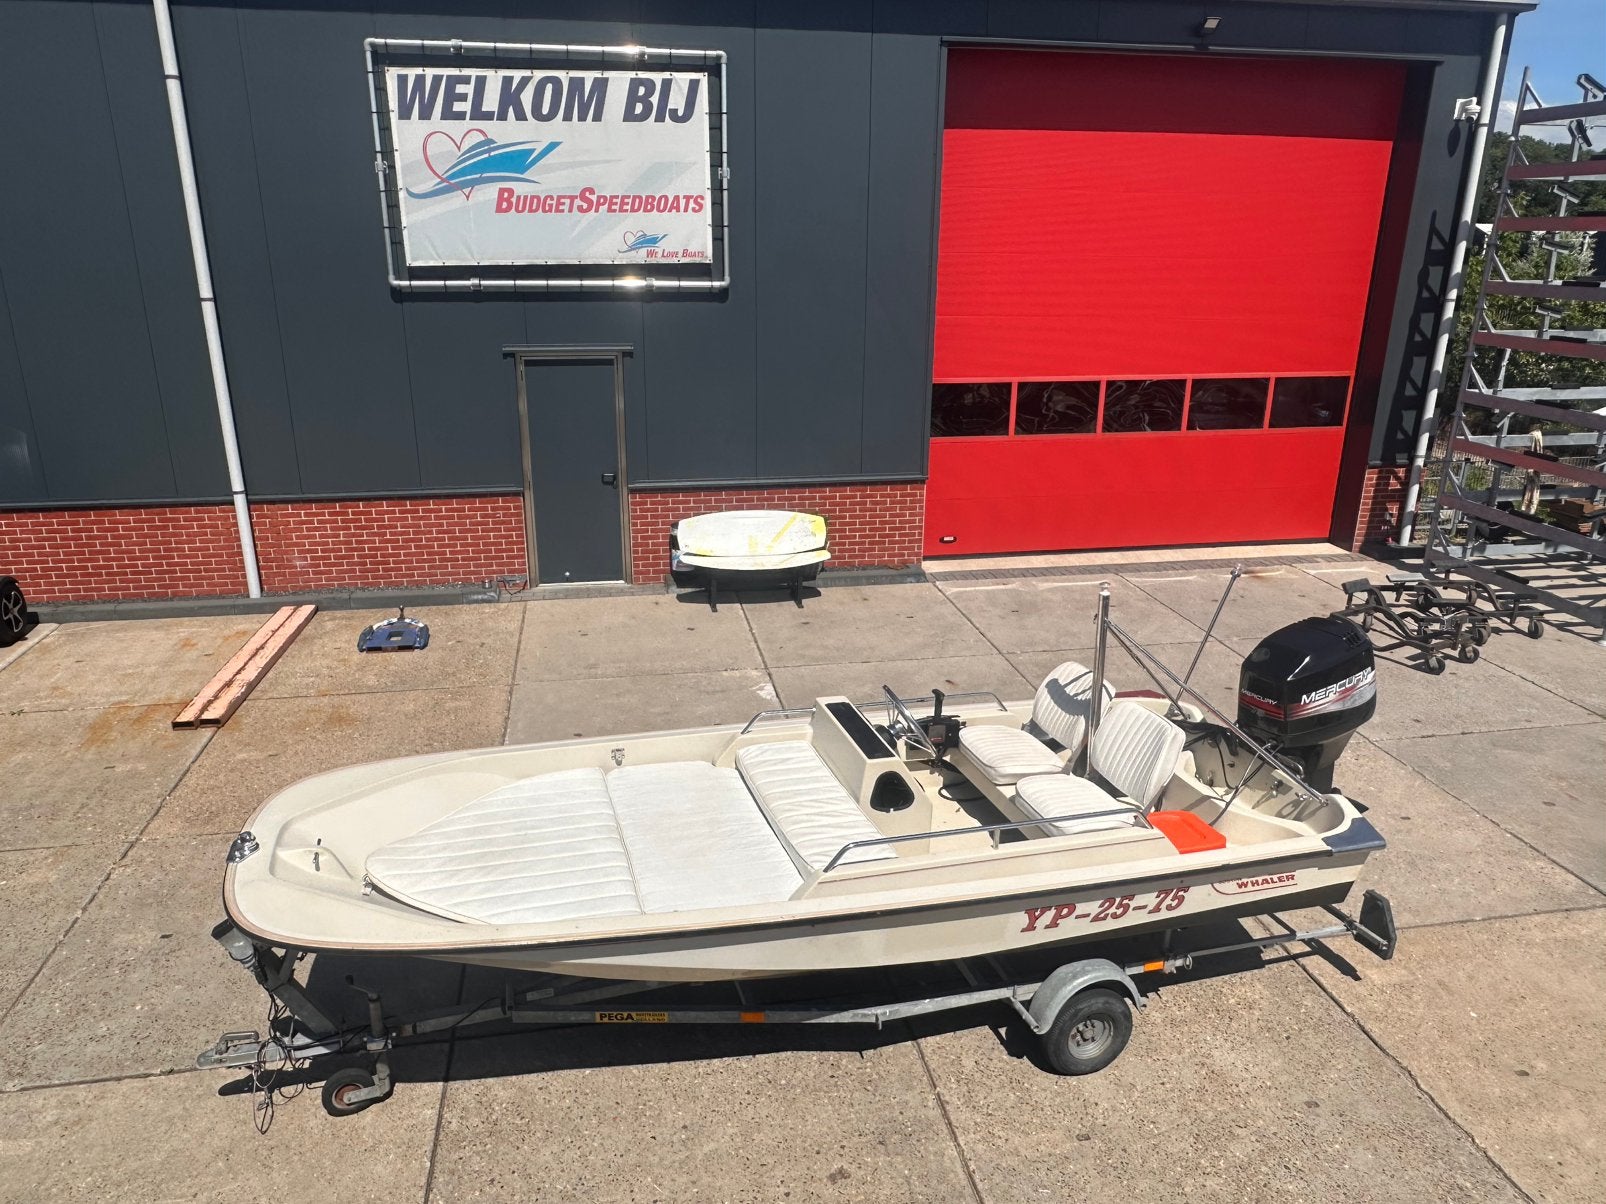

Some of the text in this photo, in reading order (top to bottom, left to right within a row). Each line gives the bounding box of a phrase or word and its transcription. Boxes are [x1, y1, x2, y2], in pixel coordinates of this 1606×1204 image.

[397, 74, 701, 123] WELKOM BIJ
[1241, 688, 1278, 705] MERCURY
[1300, 666, 1372, 705] MERCURY
[1236, 874, 1296, 889] WHALER
[1020, 886, 1192, 933] YP-25-75
[599, 1012, 634, 1021] PEGA
